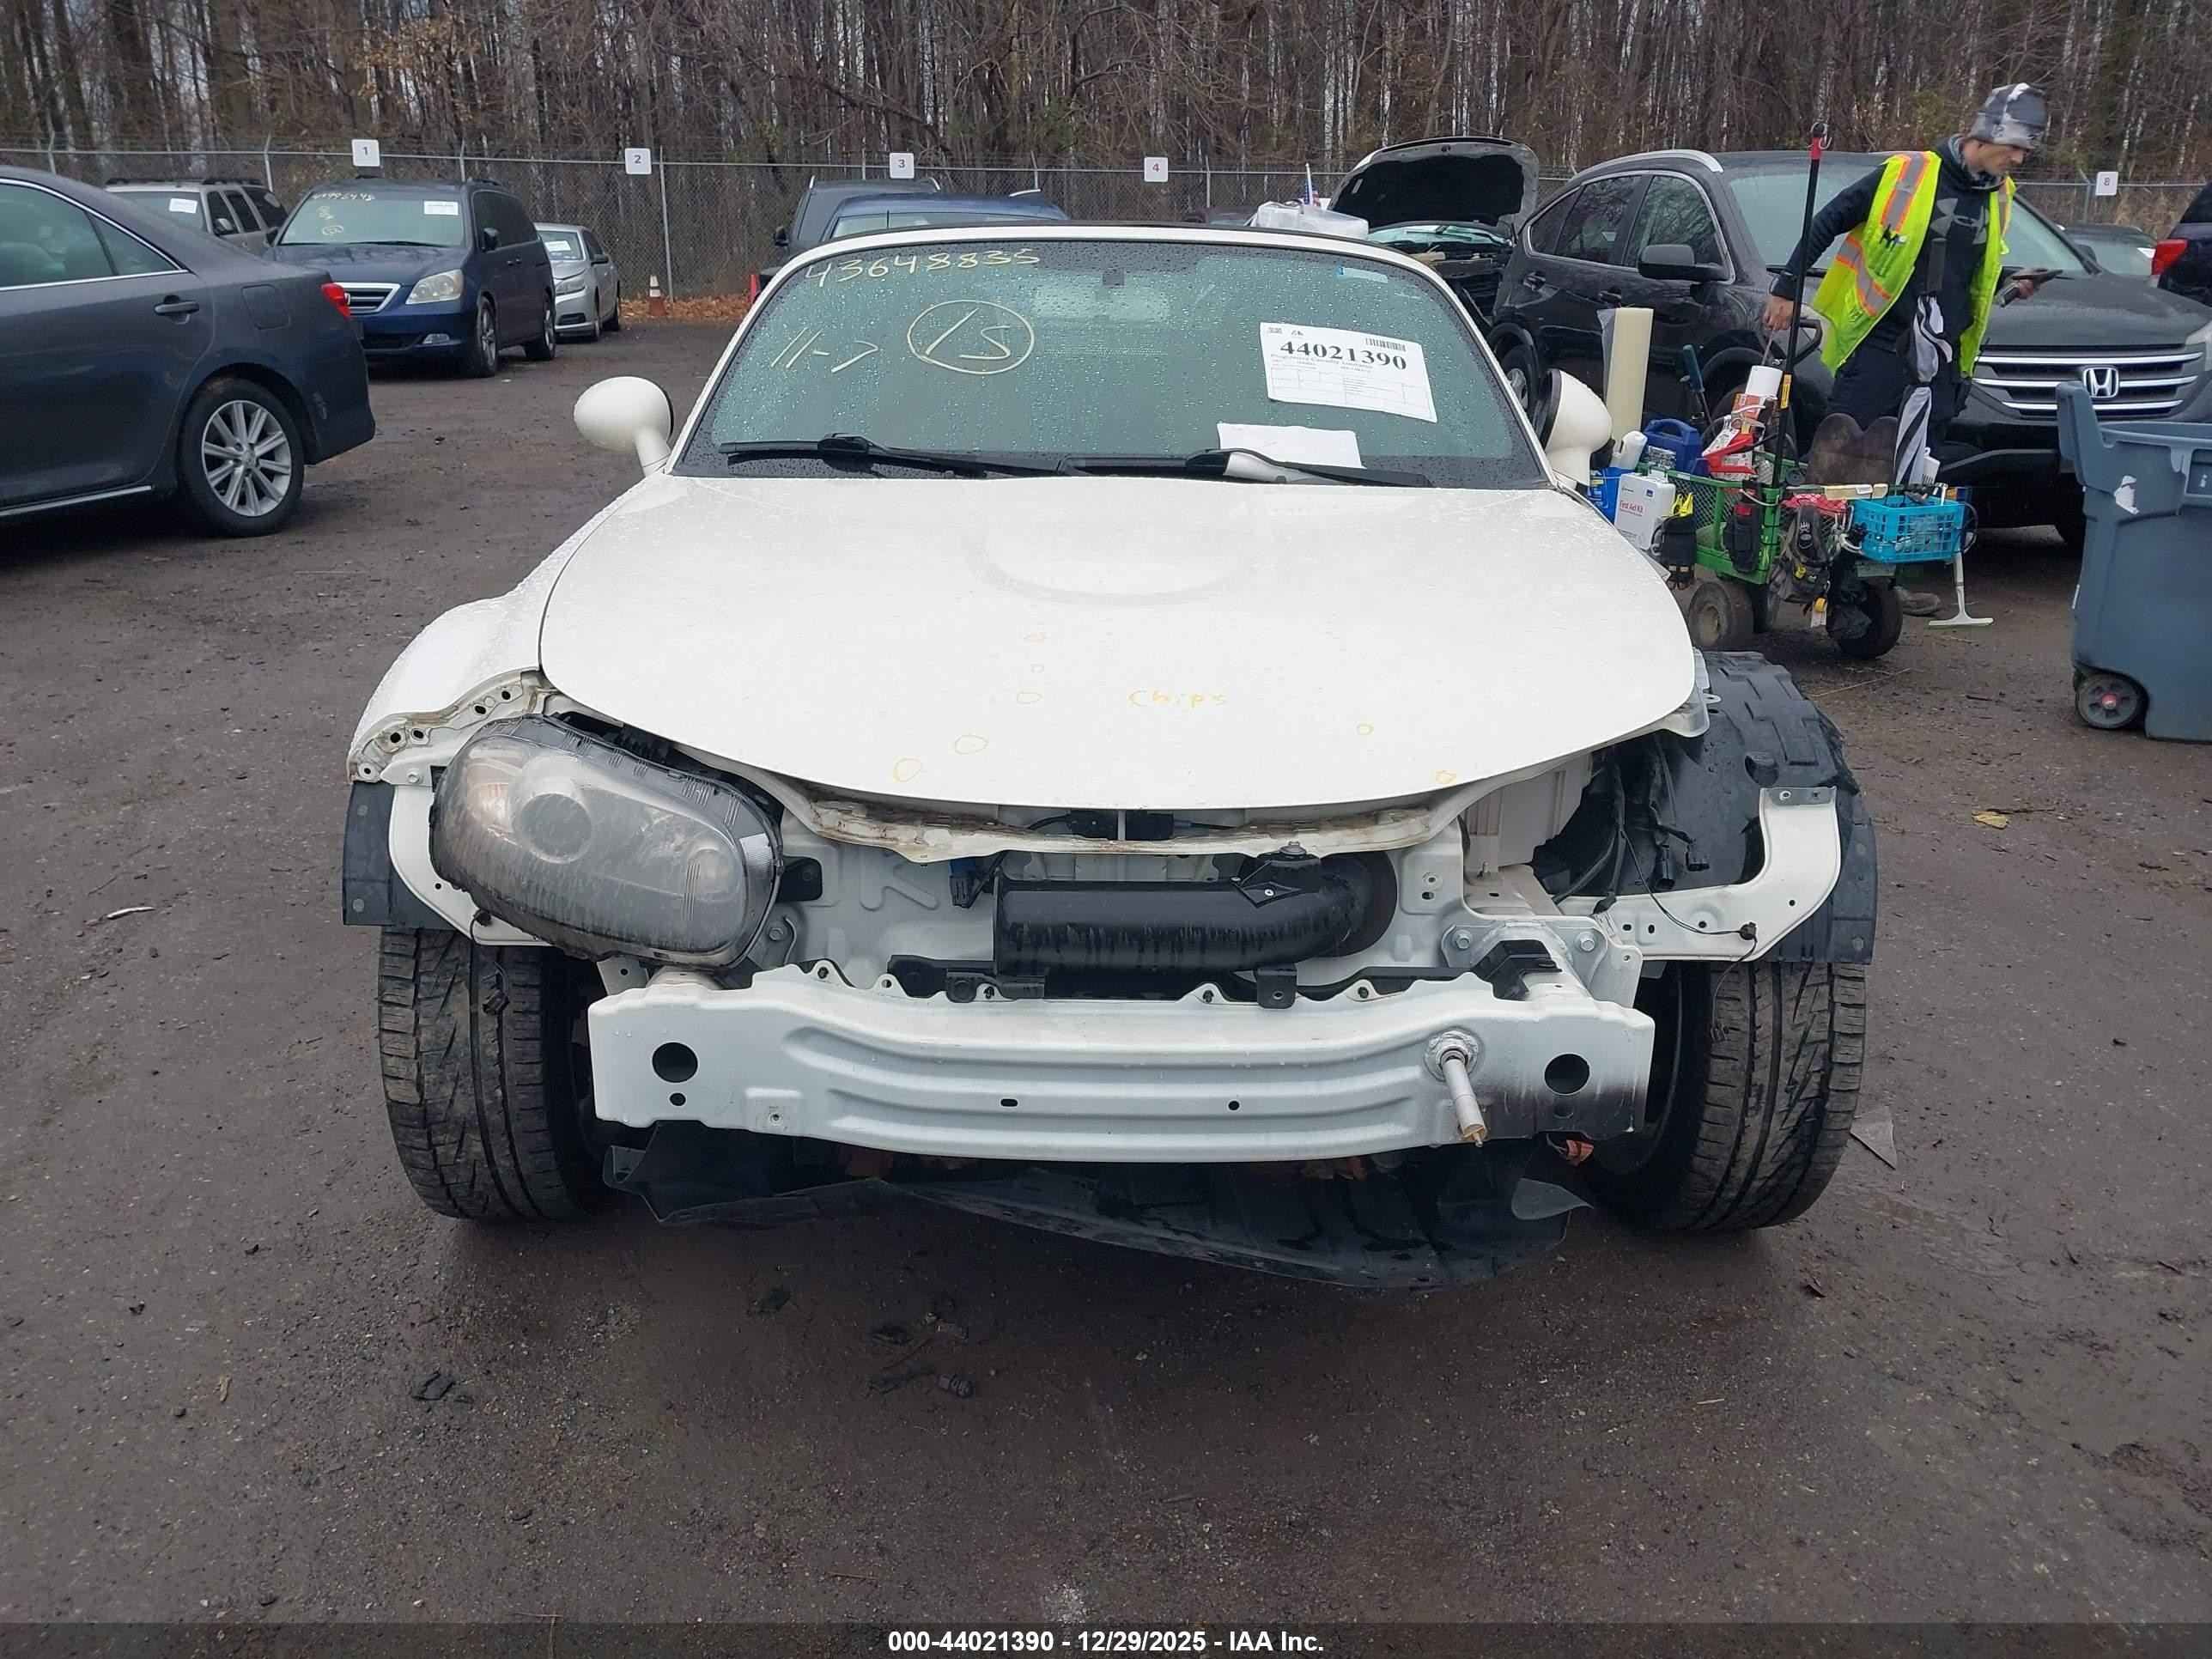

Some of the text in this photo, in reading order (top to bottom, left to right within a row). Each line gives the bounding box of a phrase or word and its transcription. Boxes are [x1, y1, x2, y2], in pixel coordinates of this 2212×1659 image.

[362, 146, 368, 155] 1
[634, 155, 642, 164] 2
[898, 159, 906, 168] 3
[1152, 163, 1161, 173] 4
[2103, 177, 2111, 186] 8
[805, 248, 1041, 288] 43648835
[1280, 341, 1407, 370] 44021390
